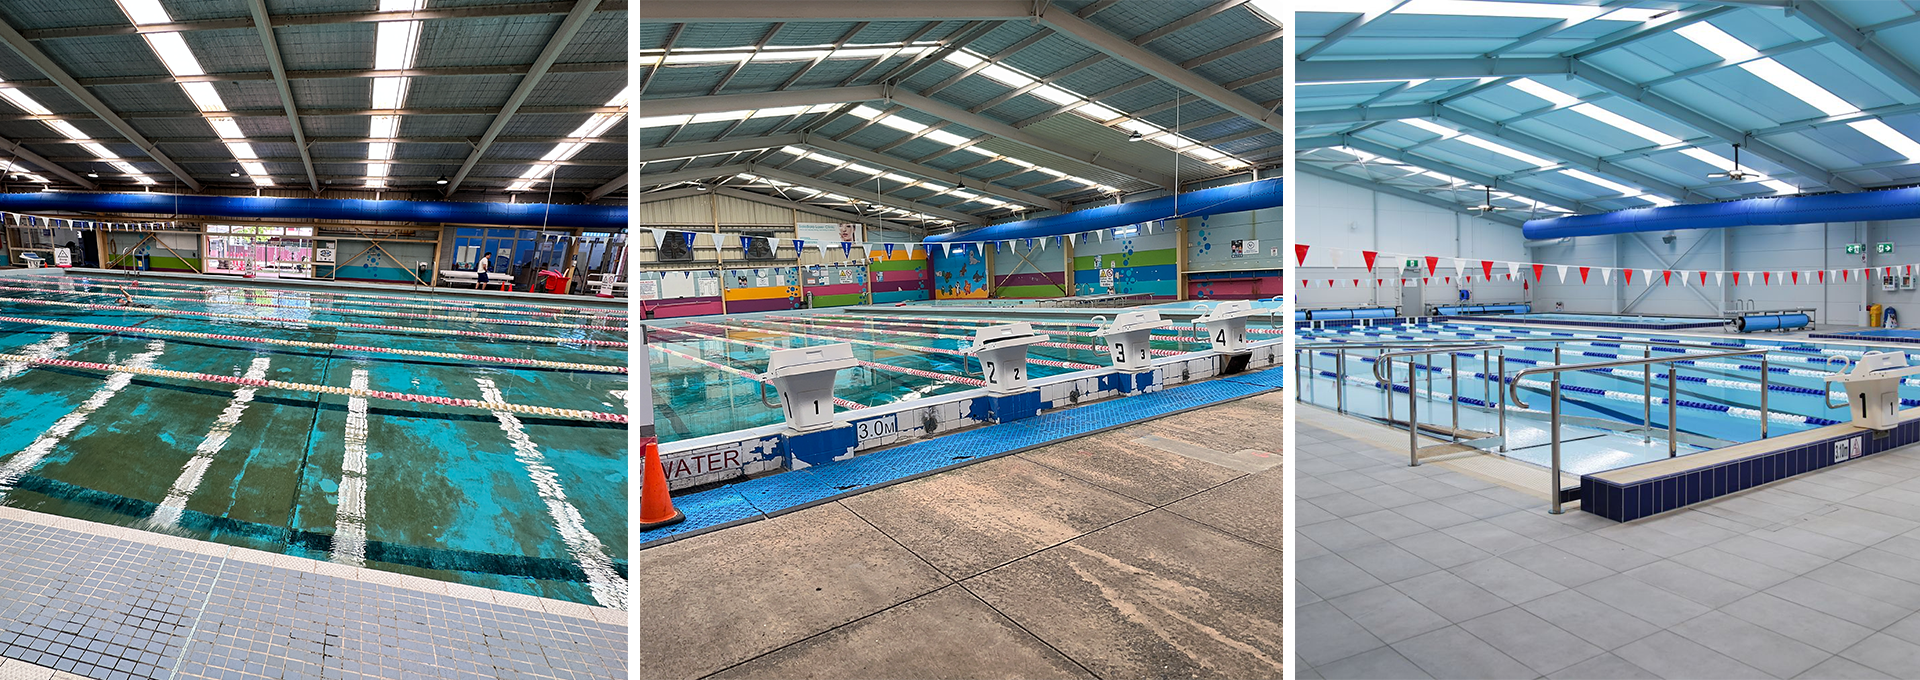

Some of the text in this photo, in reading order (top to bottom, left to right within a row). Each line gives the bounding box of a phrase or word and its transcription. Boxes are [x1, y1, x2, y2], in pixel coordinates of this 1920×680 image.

[1215, 328, 1227, 347] 4
[1238, 333, 1243, 344] 4
[1114, 342, 1126, 363] 3
[1140, 348, 1146, 360] 3
[986, 361, 998, 384] 2
[1014, 368, 1020, 380] 2
[783, 392, 793, 418] 1
[813, 399, 819, 415] 1
[1859, 392, 1867, 419] 1
[1889, 402, 1894, 415] 1
